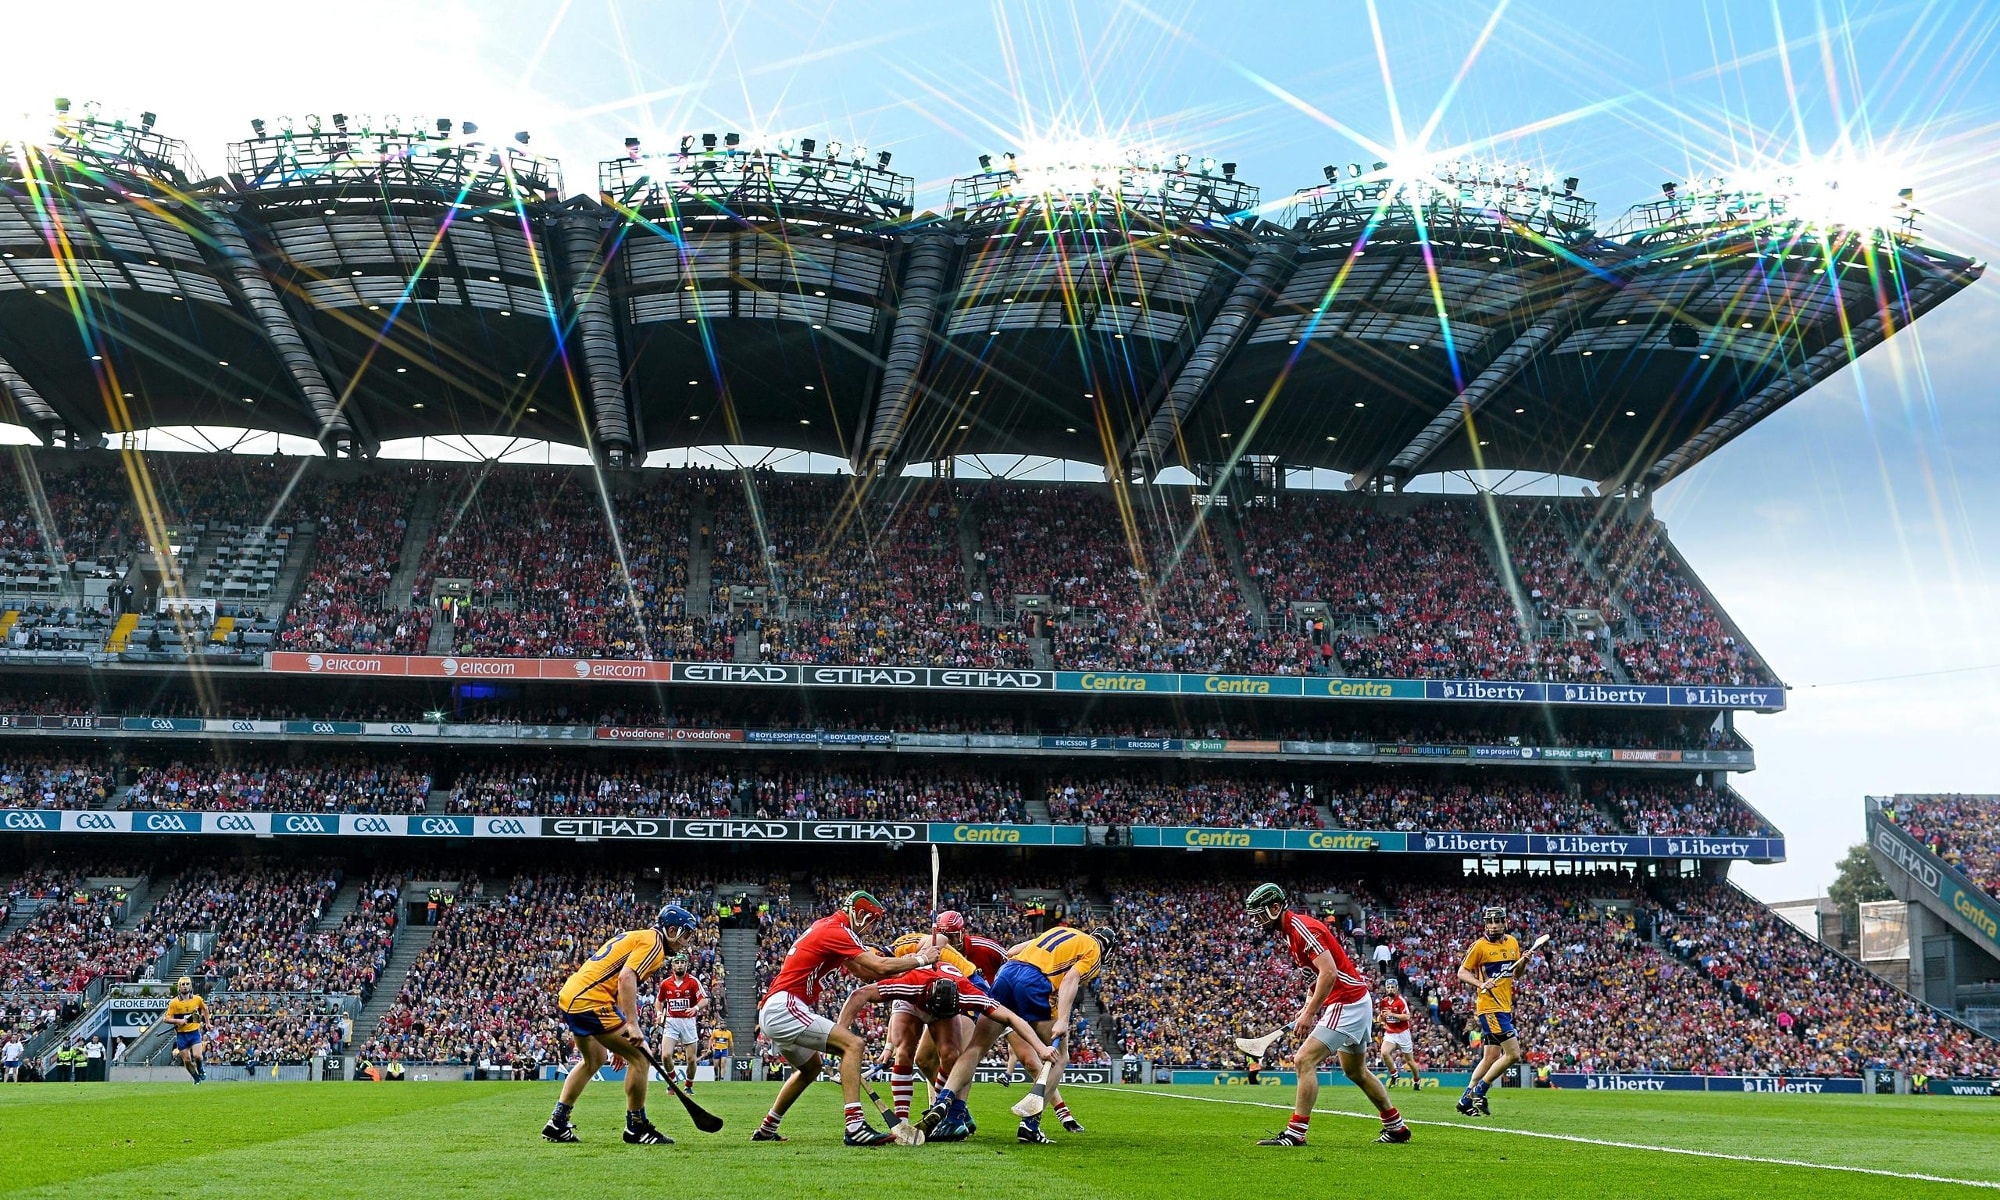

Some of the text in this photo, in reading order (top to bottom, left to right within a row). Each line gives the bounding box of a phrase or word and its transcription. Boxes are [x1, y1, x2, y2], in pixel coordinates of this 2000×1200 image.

[684, 666, 787, 681] ETIHAD
[814, 668, 916, 684] ETIHAD
[942, 671, 1042, 687] ETIHAD
[1081, 673, 1146, 691] Centra
[1205, 676, 1270, 694] Centra
[1328, 680, 1392, 696] Centra
[1456, 683, 1524, 701] Liberty
[1578, 686, 1646, 704] Liberty
[1699, 689, 1768, 706] Liberty
[71, 718, 92, 728] AIB
[151, 719, 174, 730] GAA
[232, 721, 254, 731] GAA
[313, 723, 335, 733] GAA
[391, 724, 413, 734] GAA
[620, 731, 665, 739] vodafone
[687, 731, 731, 739] vodafone
[1202, 741, 1222, 750] bam
[1491, 749, 1520, 758] property
[1545, 750, 1604, 759] SPAX SPAX
[5, 814, 46, 829] GAA
[77, 814, 116, 830] GAA
[147, 815, 187, 831] GAA
[216, 815, 256, 831] GAA
[286, 816, 326, 832] GAA
[354, 817, 392, 832] GAA
[421, 817, 460, 833] GAA
[488, 818, 526, 833] GAA
[553, 820, 659, 836] ETIHAD
[685, 821, 789, 837] ETIHAD
[814, 822, 916, 839] ETIHAD
[954, 825, 1020, 844] Centra
[1185, 829, 1250, 847] Centra
[1309, 833, 1372, 849] Centra
[1437, 835, 1507, 853] Liberty
[1560, 837, 1629, 857] Liberty
[1680, 840, 1749, 858] Liberty
[1879, 832, 1937, 888] ETIHAD
[1954, 890, 1998, 939] Centra
[1036, 929, 1076, 953] 11
[113, 1000, 170, 1008] CROKE PARK
[327, 1059, 339, 1069] 32
[736, 1061, 747, 1070] 33
[1126, 1063, 1137, 1072] 34
[1506, 1068, 1517, 1077] 35
[1879, 1074, 1890, 1083] 36
[1598, 1077, 1664, 1091] Liberty
